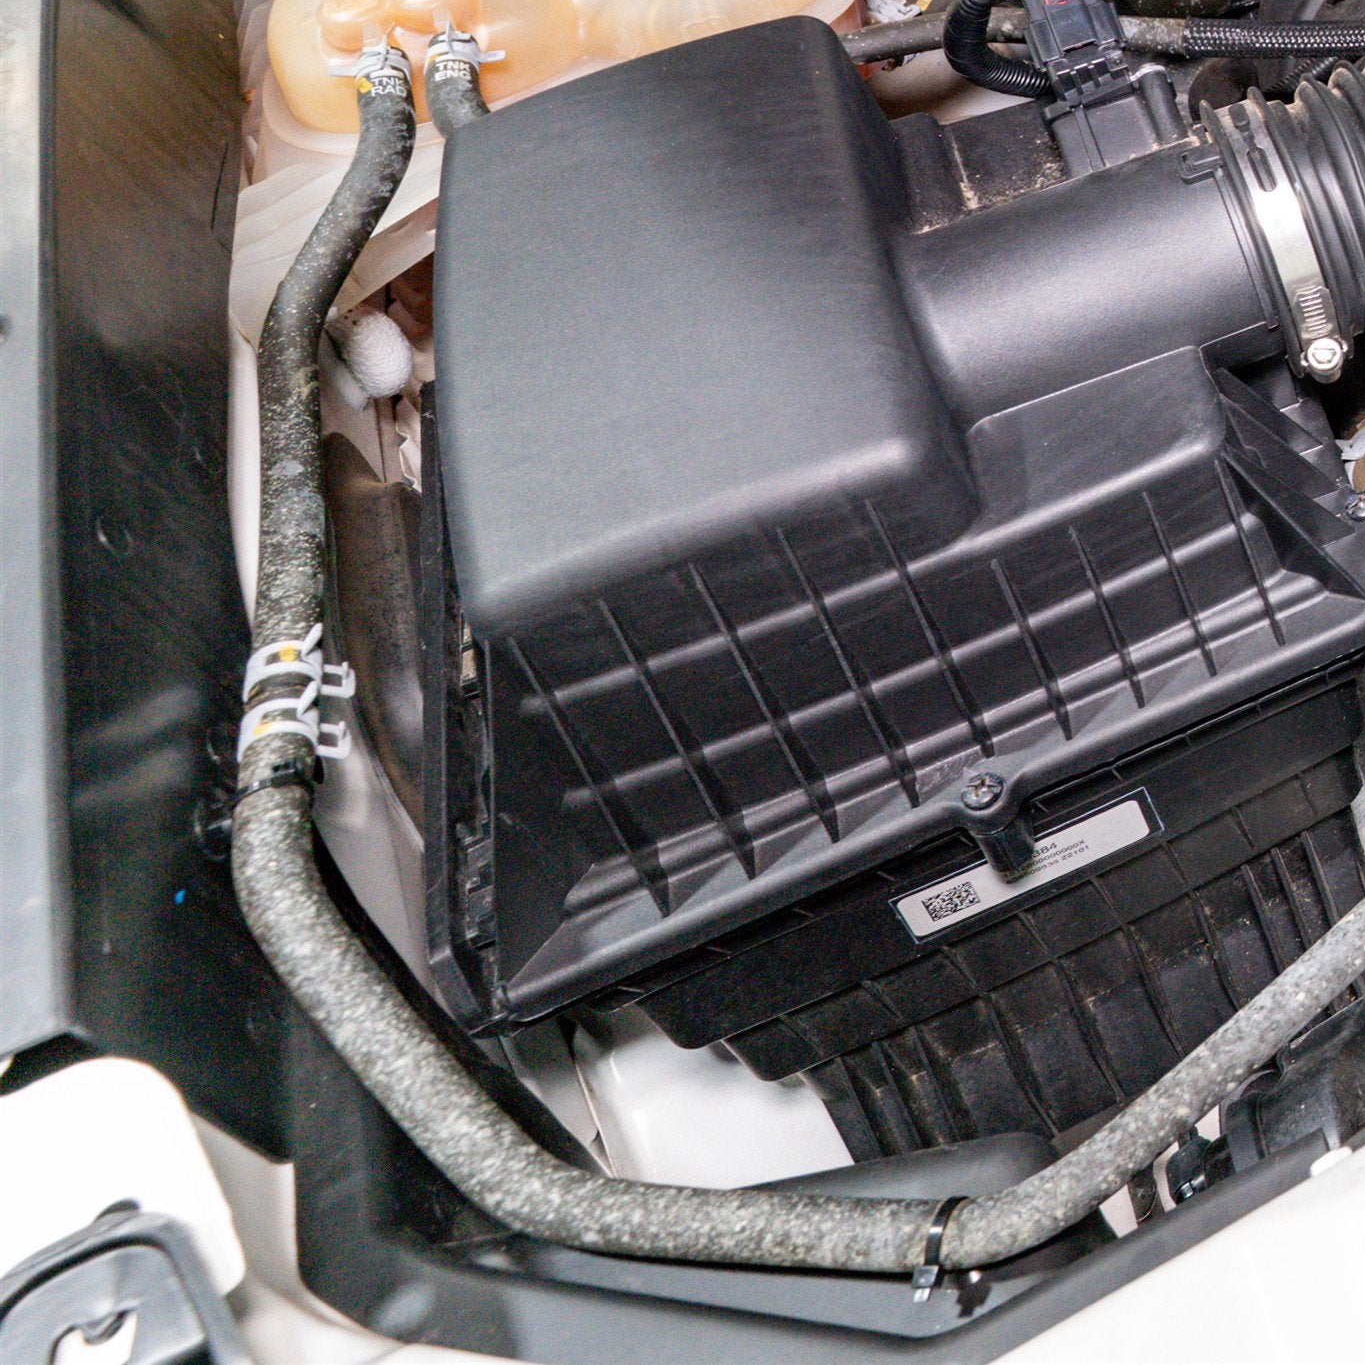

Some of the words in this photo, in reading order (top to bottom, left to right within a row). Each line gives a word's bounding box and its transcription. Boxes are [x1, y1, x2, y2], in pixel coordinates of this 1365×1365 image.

[434, 61, 472, 72] TNK
[370, 76, 406, 86] TNK
[433, 69, 472, 82] ENG
[369, 86, 408, 98] RAD
